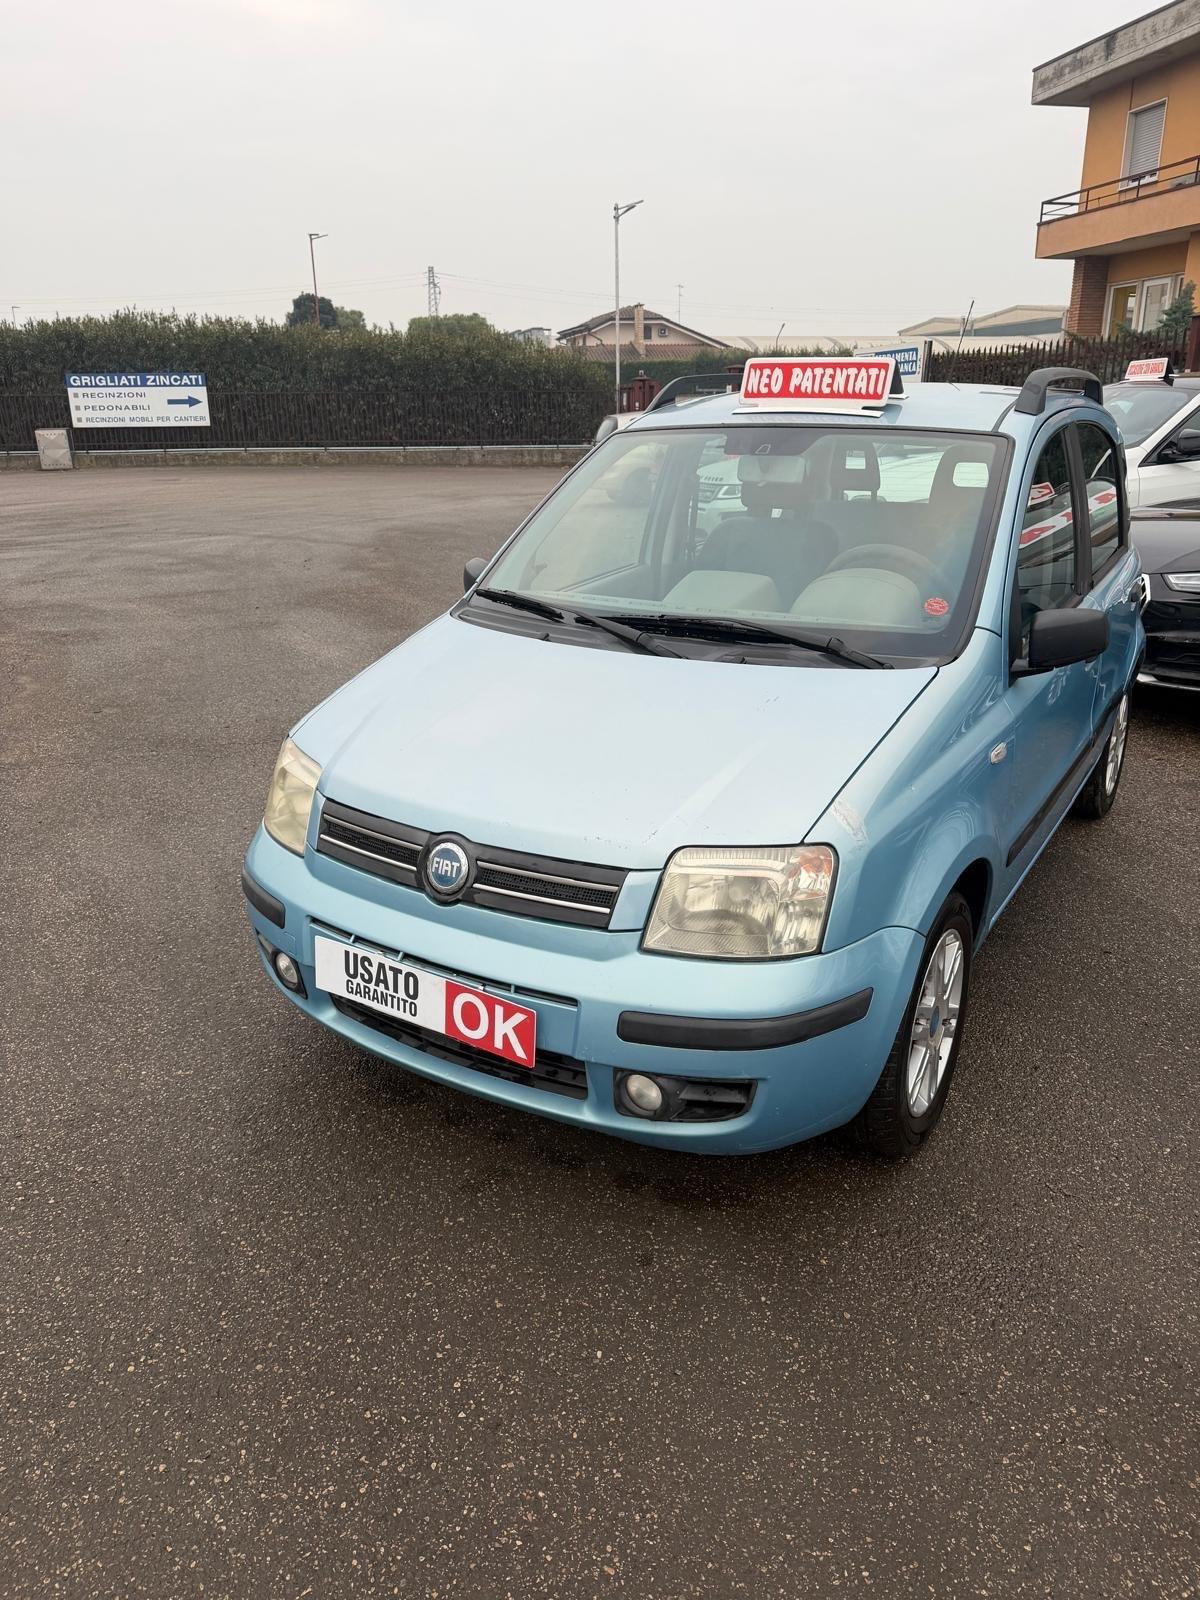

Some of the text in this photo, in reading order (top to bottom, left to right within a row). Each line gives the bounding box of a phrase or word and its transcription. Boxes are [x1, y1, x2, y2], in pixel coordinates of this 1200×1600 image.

[70, 375, 202, 386] GRIGLIATI ZINCATI
[747, 367, 886, 395] NEO PATENTATI
[898, 361, 917, 373] ANCA
[432, 857, 460, 878] FIAT
[344, 949, 419, 1001] USATO
[346, 979, 418, 1017] GARANTITO
[452, 992, 529, 1060] OK
